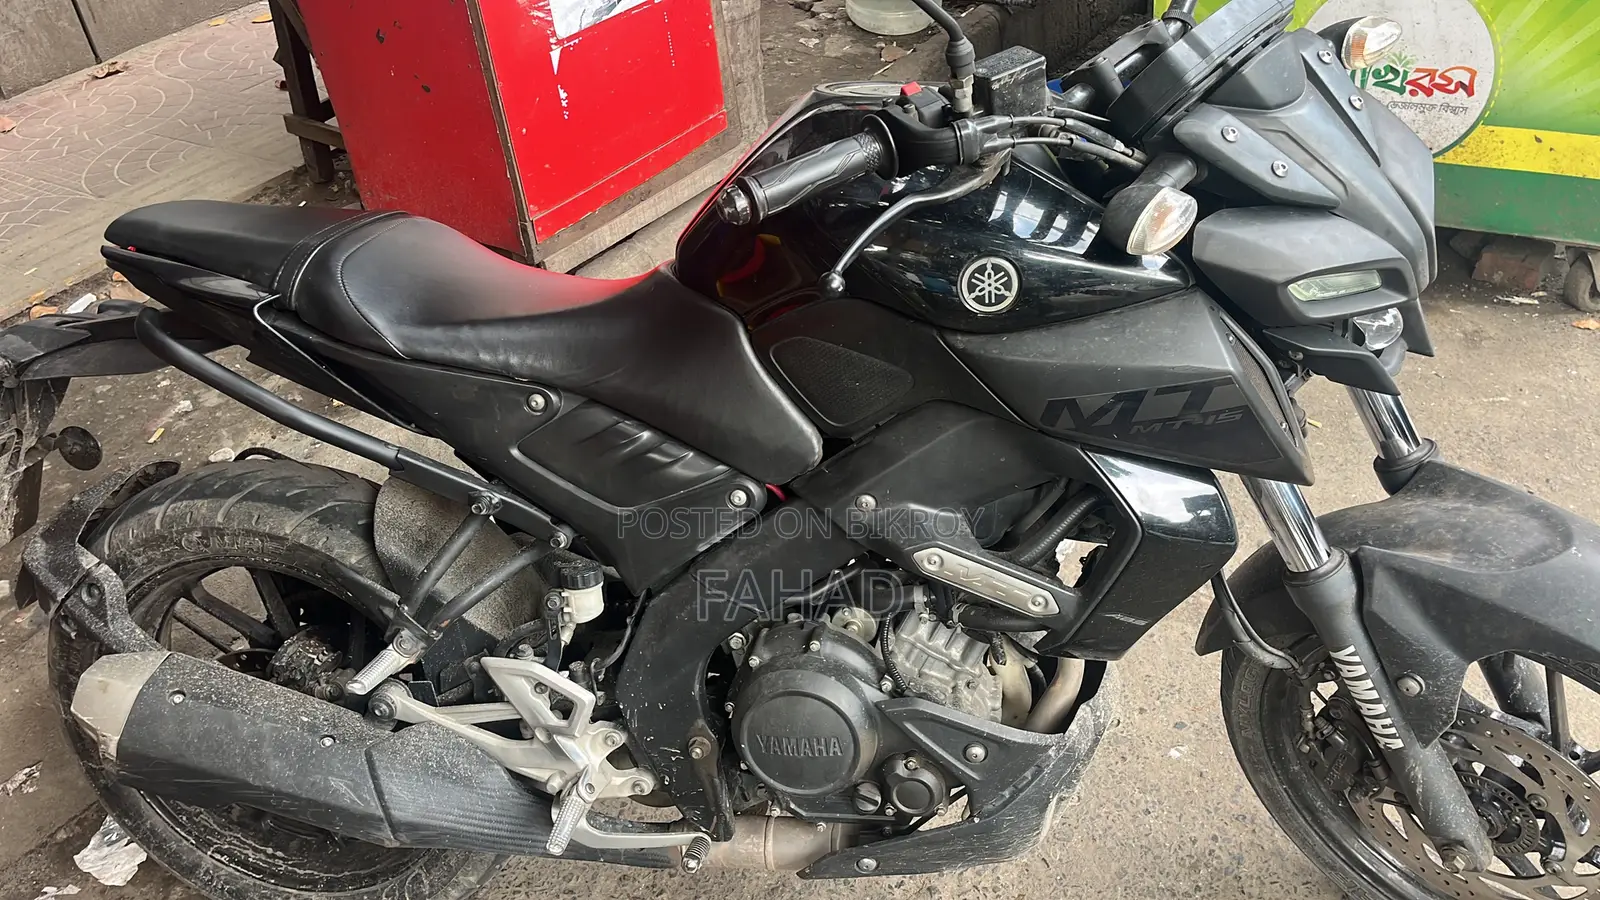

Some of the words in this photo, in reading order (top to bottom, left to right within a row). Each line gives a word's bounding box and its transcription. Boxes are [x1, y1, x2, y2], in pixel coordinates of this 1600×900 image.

[1039, 376, 1238, 432] MT
[1329, 645, 1405, 750] YAMAHA
[756, 734, 843, 757] YAMAHA
